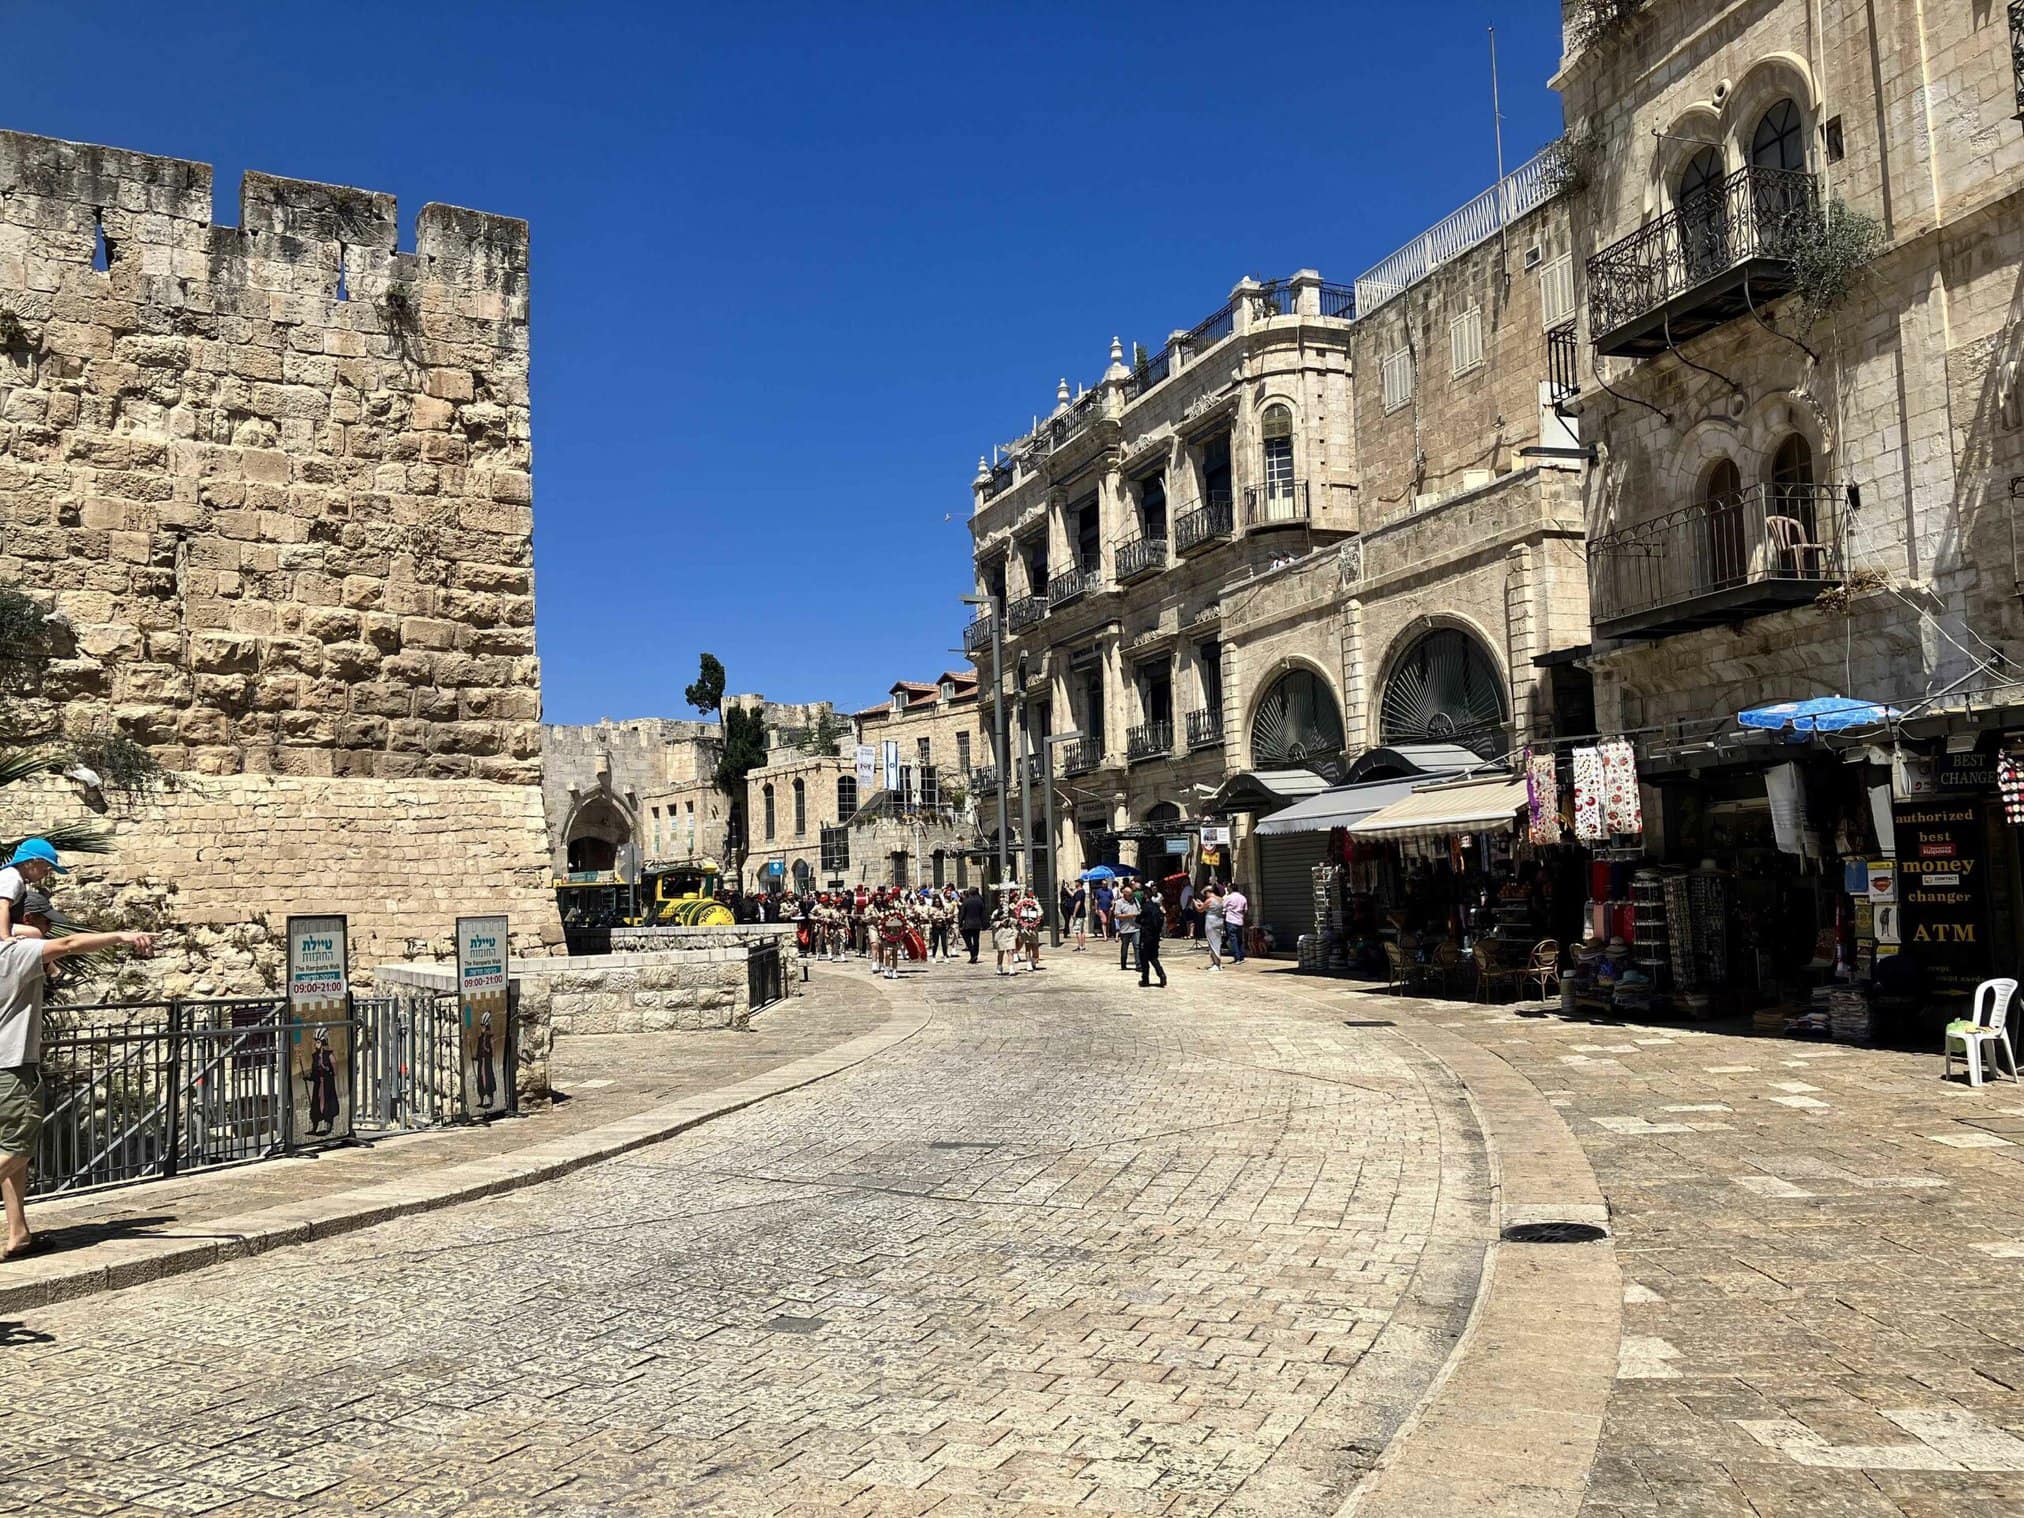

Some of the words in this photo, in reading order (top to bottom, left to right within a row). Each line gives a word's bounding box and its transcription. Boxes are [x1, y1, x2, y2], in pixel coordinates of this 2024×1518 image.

[1953, 754, 1985, 767] BEST
[1940, 771, 1995, 785] CHANGE
[1896, 808, 1974, 824] authorized
[1919, 831, 1951, 842] best
[1902, 859, 1975, 875] money
[1908, 890, 1972, 904] changer
[1913, 923, 1976, 941] ATM
[302, 935, 333, 951] טיילת
[470, 934, 496, 948] טיילת
[294, 982, 341, 993] 09:00-21:00
[464, 975, 502, 987] 09:00-21:00
